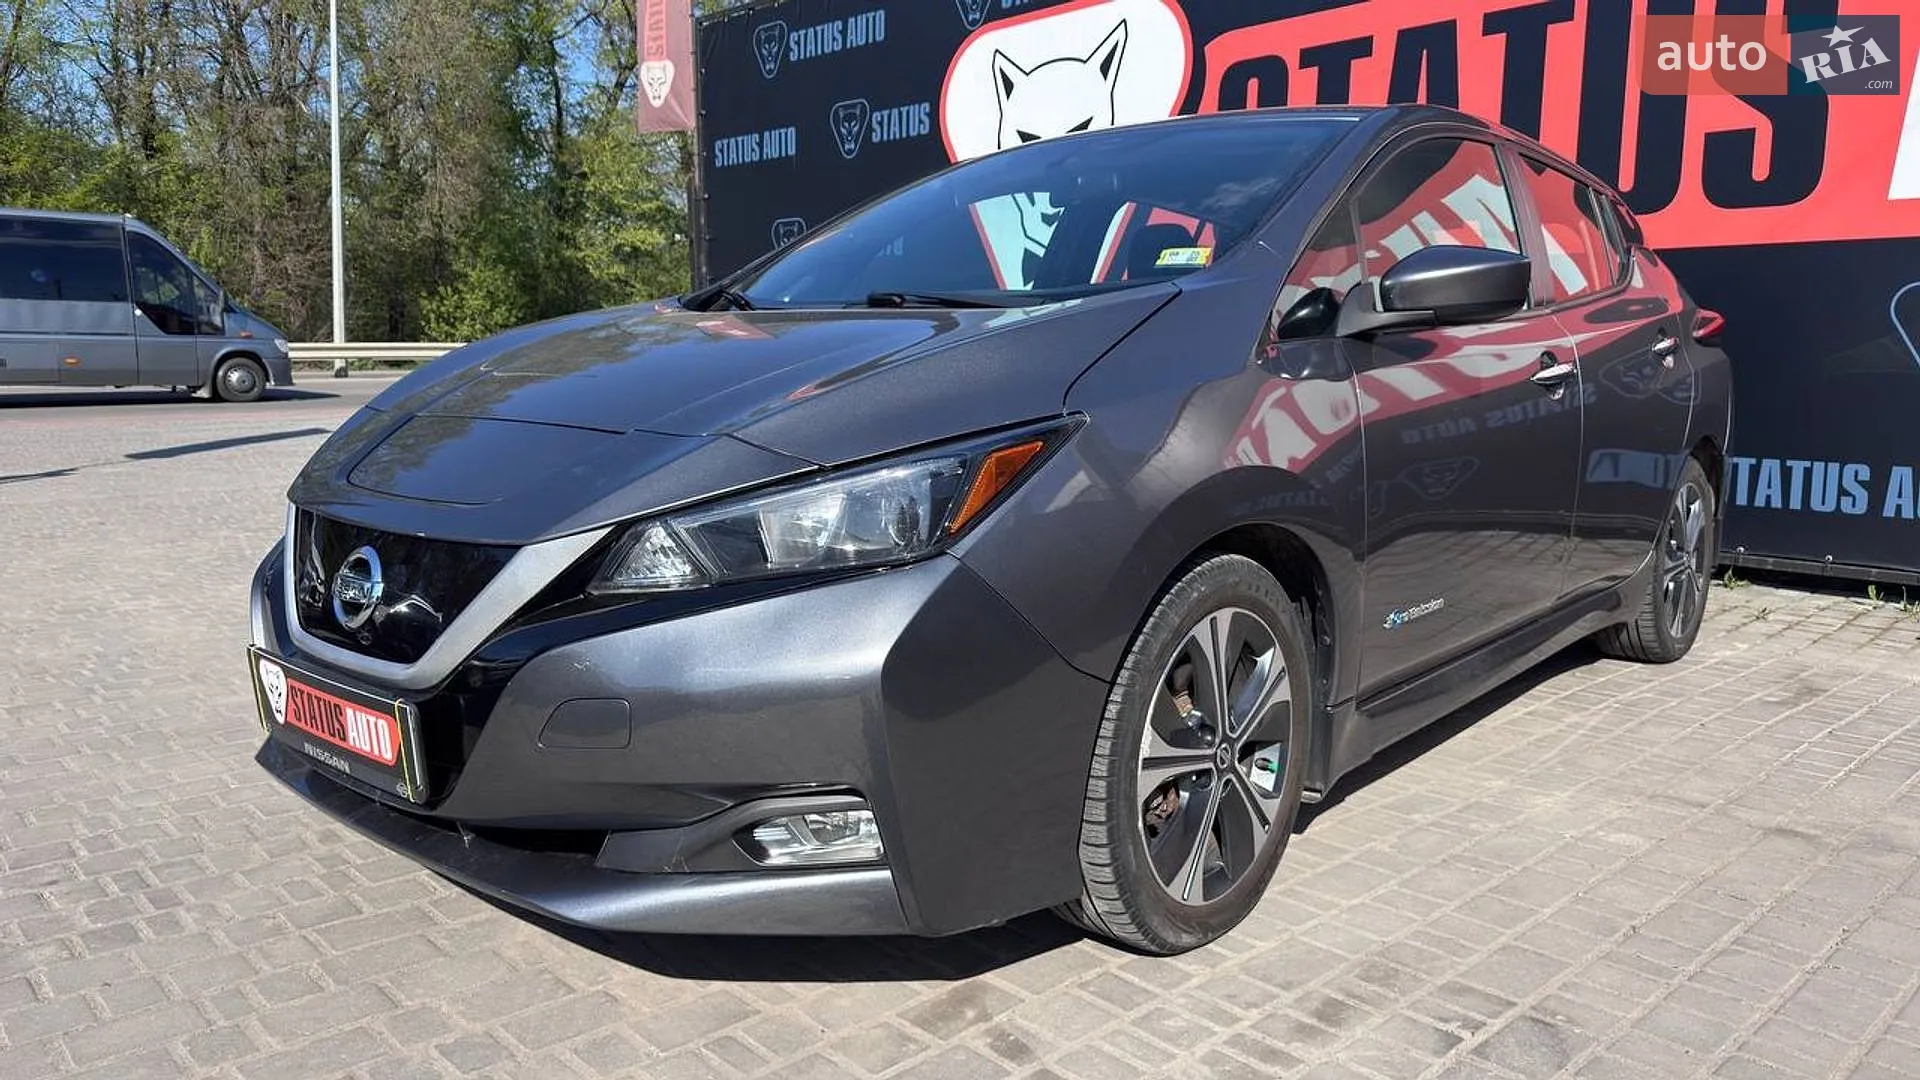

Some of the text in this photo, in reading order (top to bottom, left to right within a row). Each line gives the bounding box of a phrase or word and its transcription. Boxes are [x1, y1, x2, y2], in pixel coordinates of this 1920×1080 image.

[789, 10, 885, 62] STATUS AUTO
[871, 102, 931, 143] STATUS
[714, 126, 797, 168] STATUS AUTO
[1732, 457, 1871, 515] TATUS
[1882, 465, 1920, 520] A
[290, 682, 393, 761] STATUS AUTO
[304, 743, 351, 773] NISSAN
